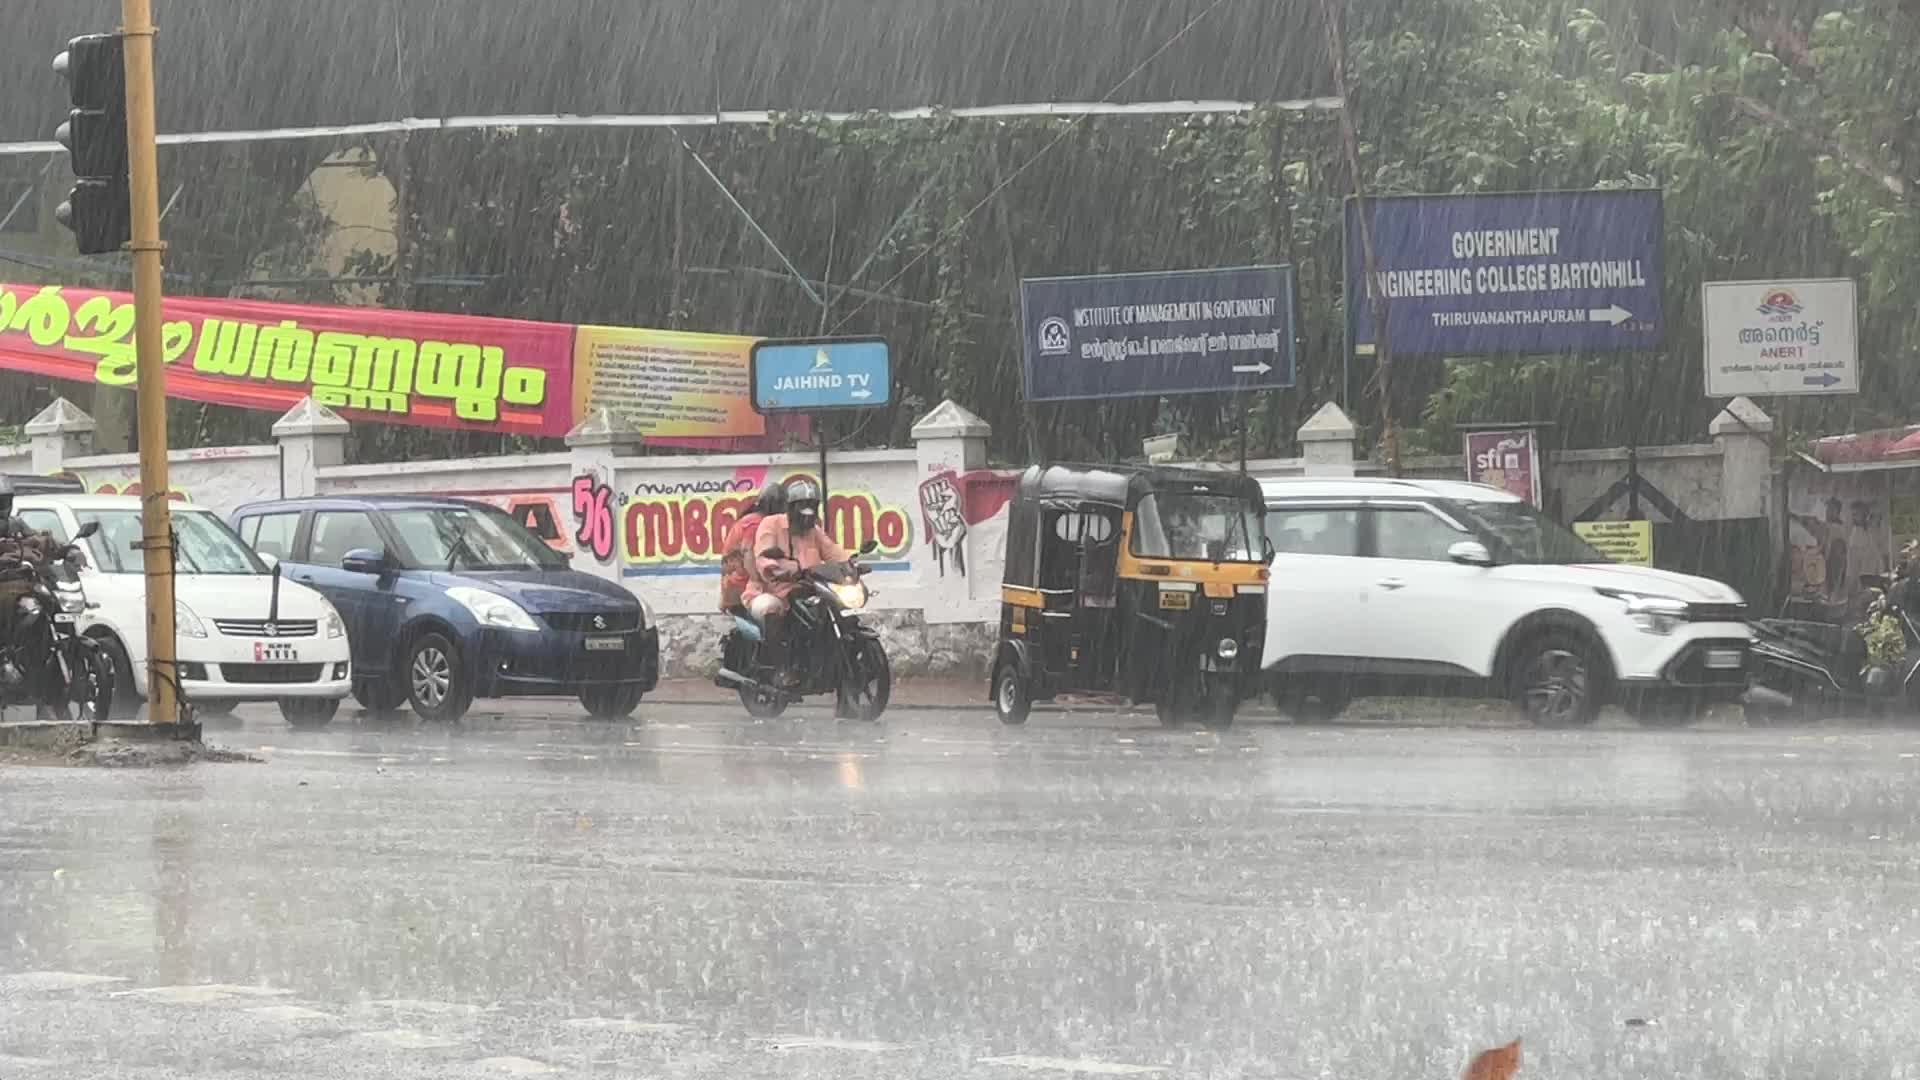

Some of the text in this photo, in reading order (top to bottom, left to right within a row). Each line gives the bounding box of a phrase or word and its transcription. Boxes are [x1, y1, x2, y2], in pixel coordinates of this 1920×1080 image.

[1452, 228, 1559, 258] GOVERNMENT
[1476, 264, 1547, 293] COLLEGE
[1551, 260, 1646, 290] BARTONHILL
[1073, 298, 1276, 327] INSTITUTE OF MANAGEMENT IN GOVERNMENT
[1432, 308, 1585, 327] THIRUVANANTHAPURAM
[1760, 346, 1804, 359] ANERT
[773, 373, 870, 391] JAIHIND TV
